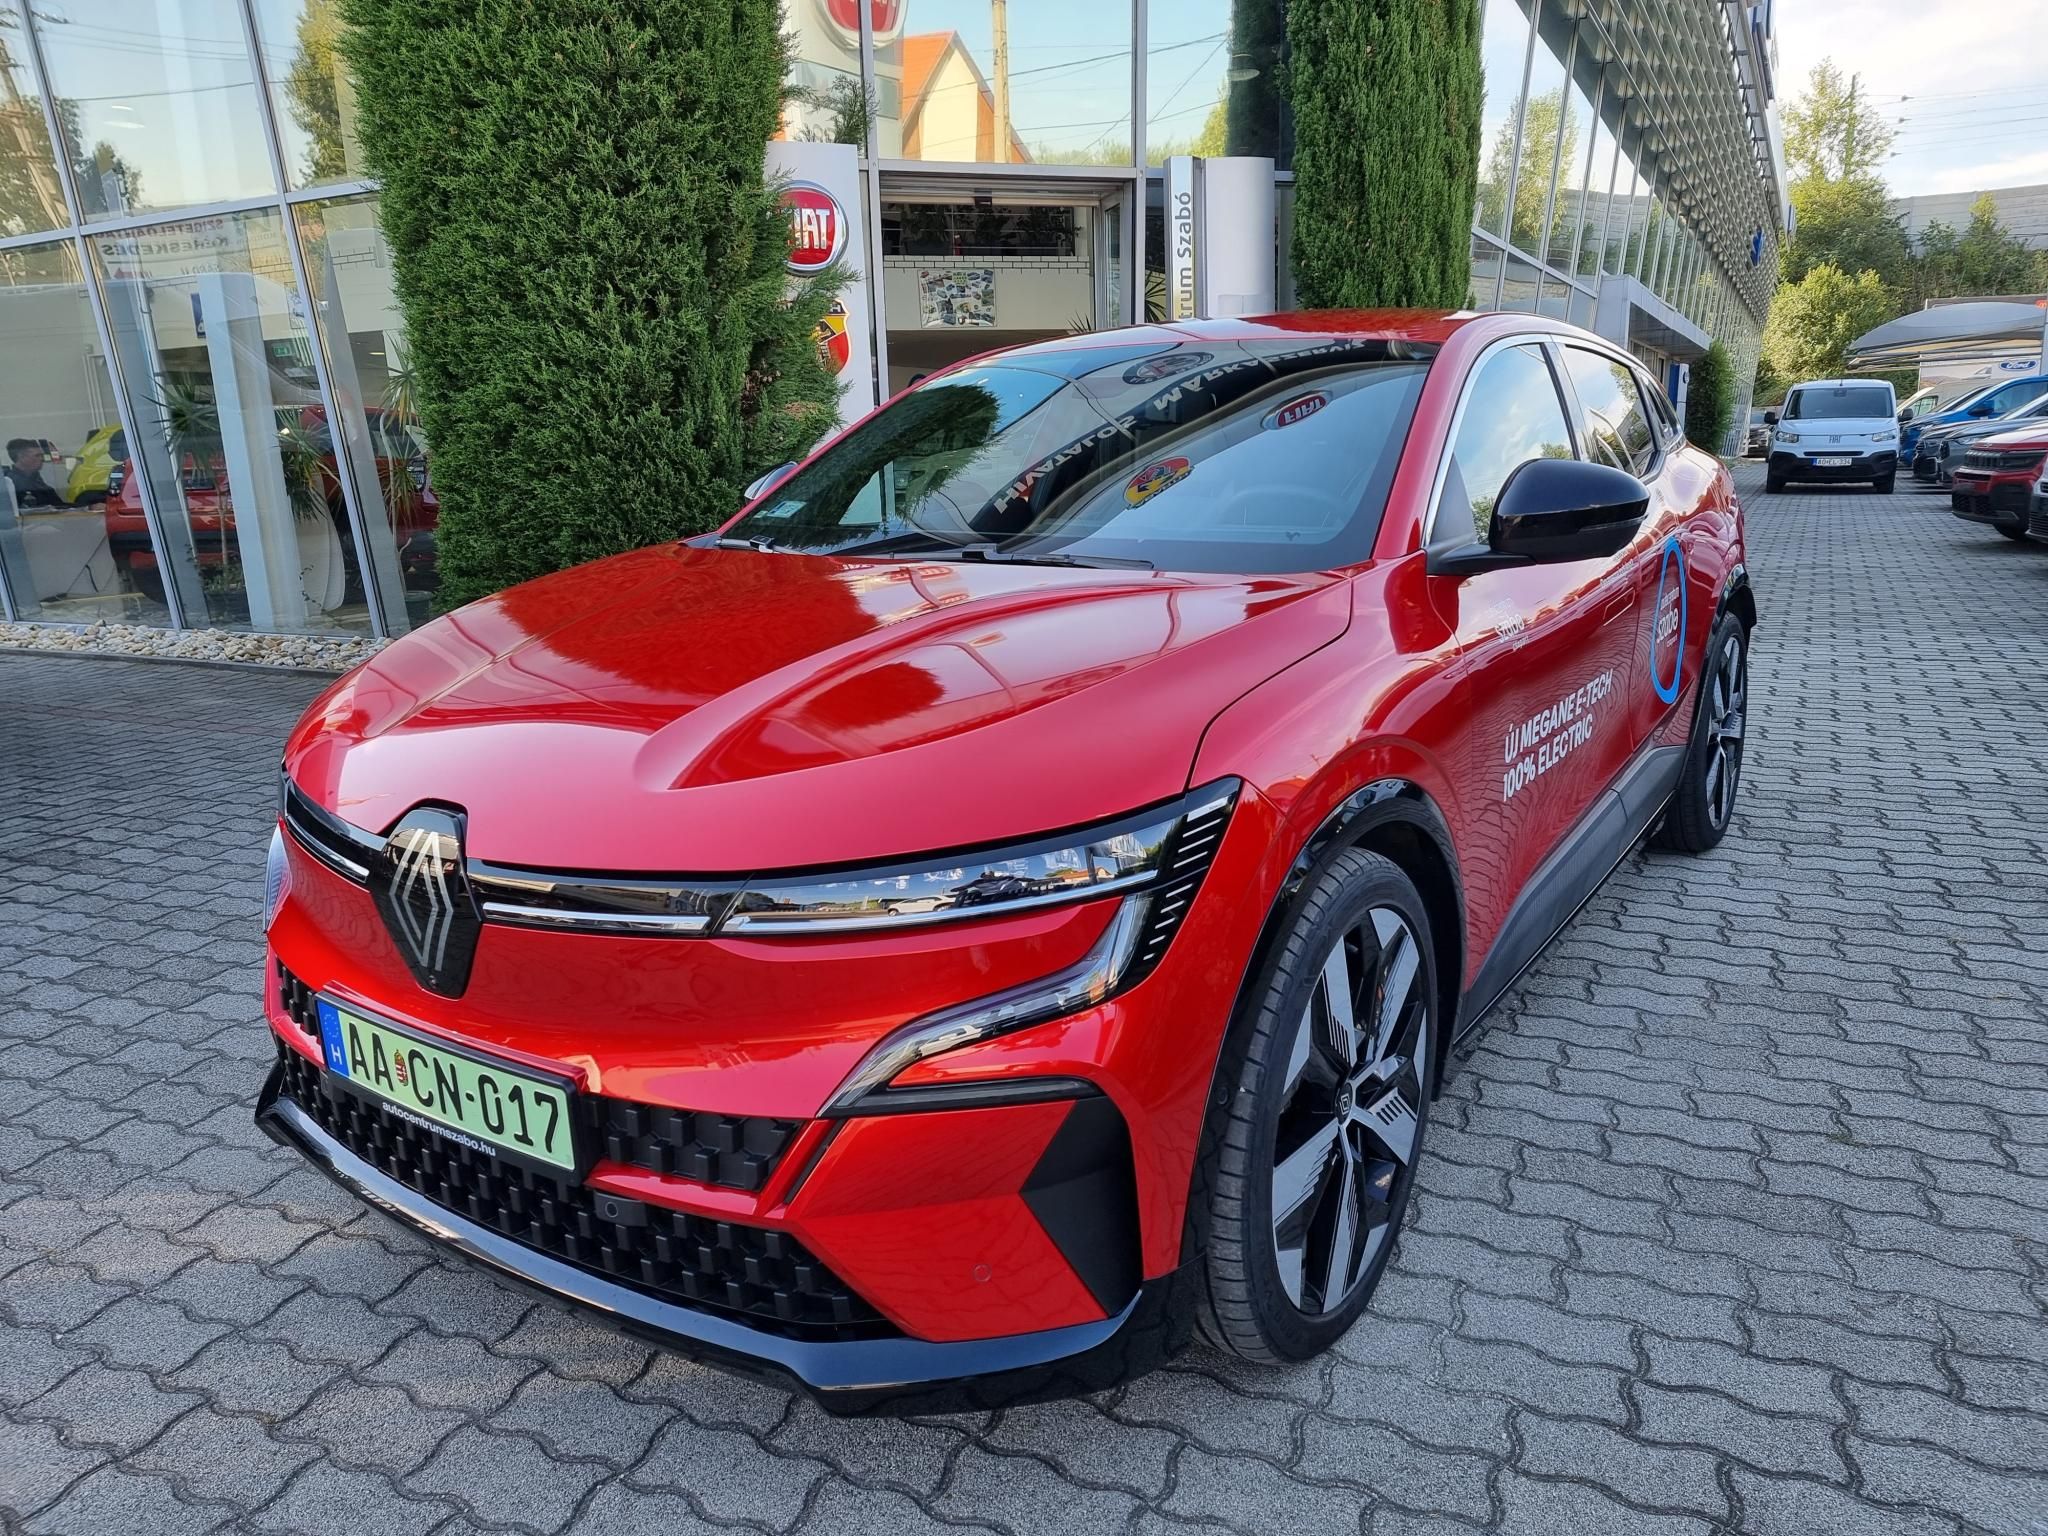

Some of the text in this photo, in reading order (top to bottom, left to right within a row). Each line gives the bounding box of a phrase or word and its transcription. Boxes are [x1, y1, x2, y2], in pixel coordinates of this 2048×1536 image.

[787, 208, 830, 249] IAT
[1175, 192, 1192, 259] Szabó
[1504, 668, 1614, 764] ÚJ MEGANE E-TECH
[1503, 713, 1593, 802] 100% ELECTRIC
[331, 1043, 343, 1065] H
[382, 1101, 496, 1157] autocentrumszabo.hu
